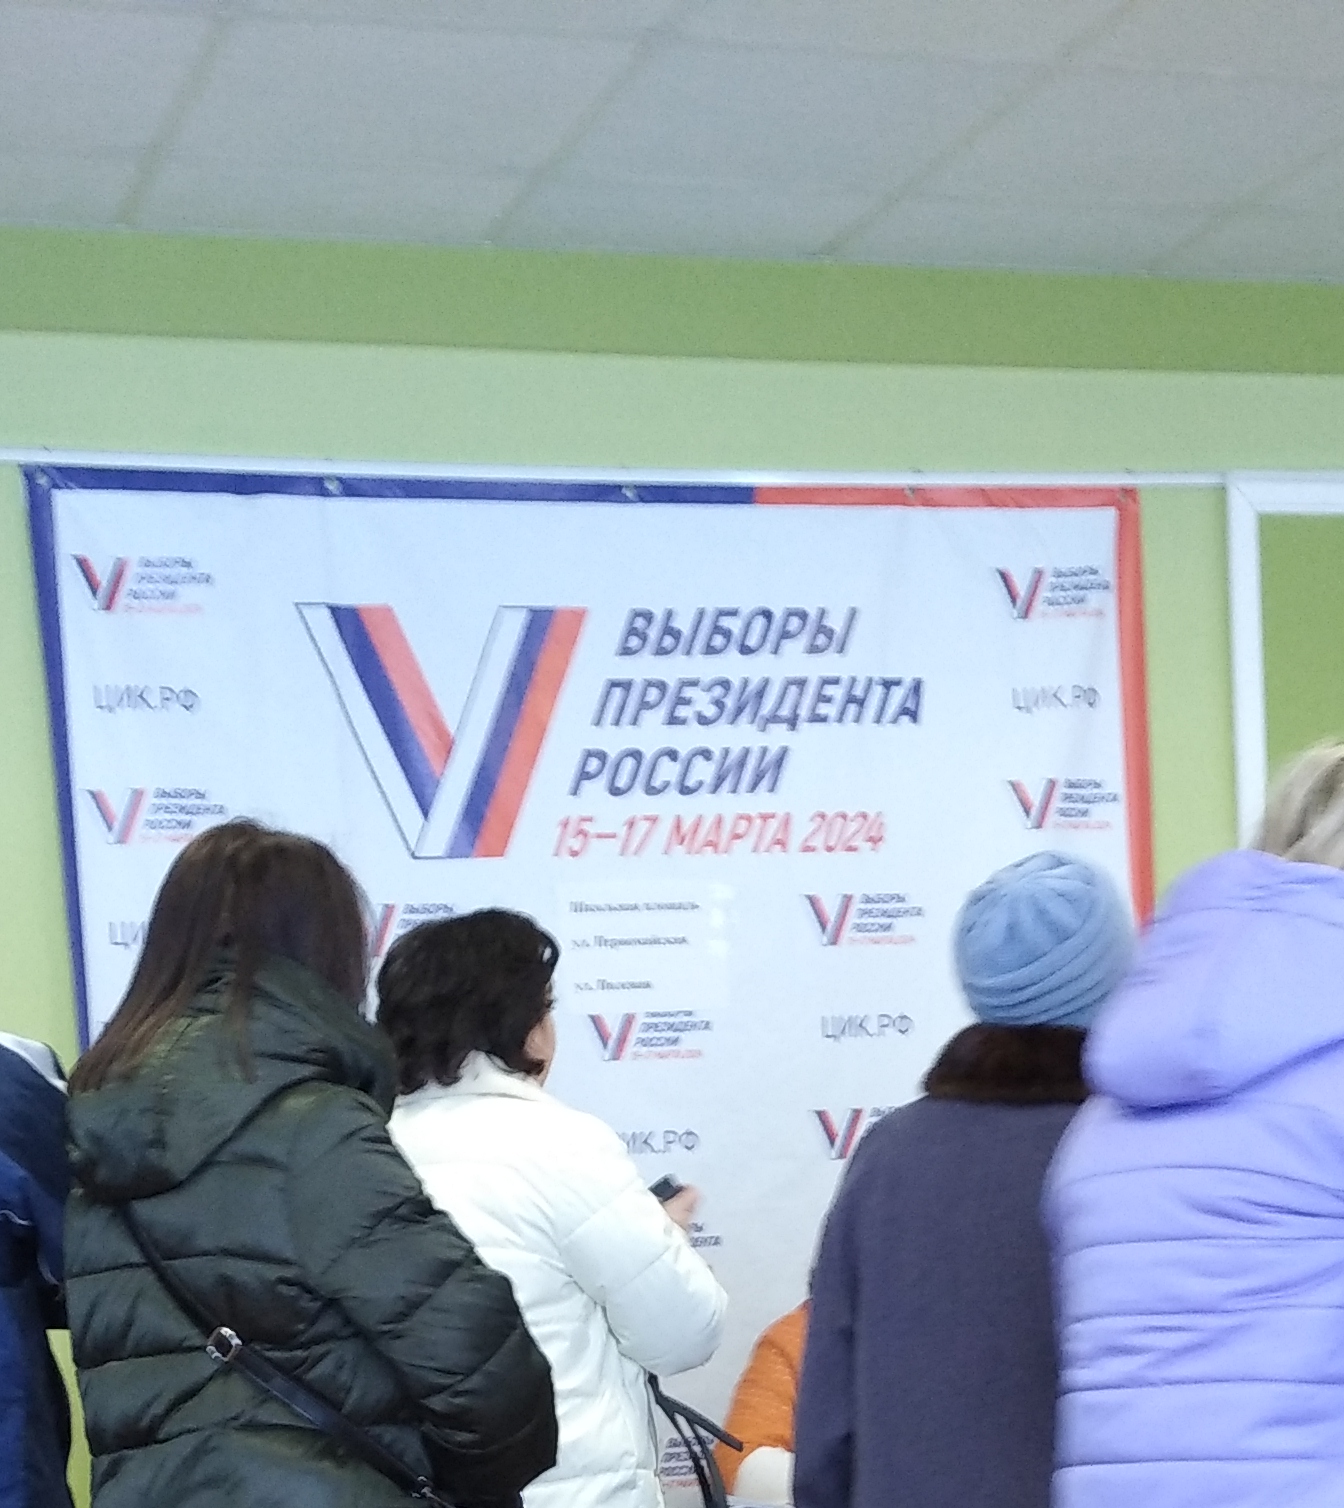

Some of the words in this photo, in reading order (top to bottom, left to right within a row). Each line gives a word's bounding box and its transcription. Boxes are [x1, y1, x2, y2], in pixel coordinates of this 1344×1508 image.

[616, 607, 860, 657] ВЫБОРЫ
[92, 684, 200, 715] ЦИК.РФ
[591, 676, 925, 732] ПРЕЗИДЕНТА
[567, 745, 791, 797] РОССИИ
[661, 812, 793, 856] МАРТА
[798, 809, 886, 853] 2024
[821, 1013, 915, 1043] ЦИК.РФ
